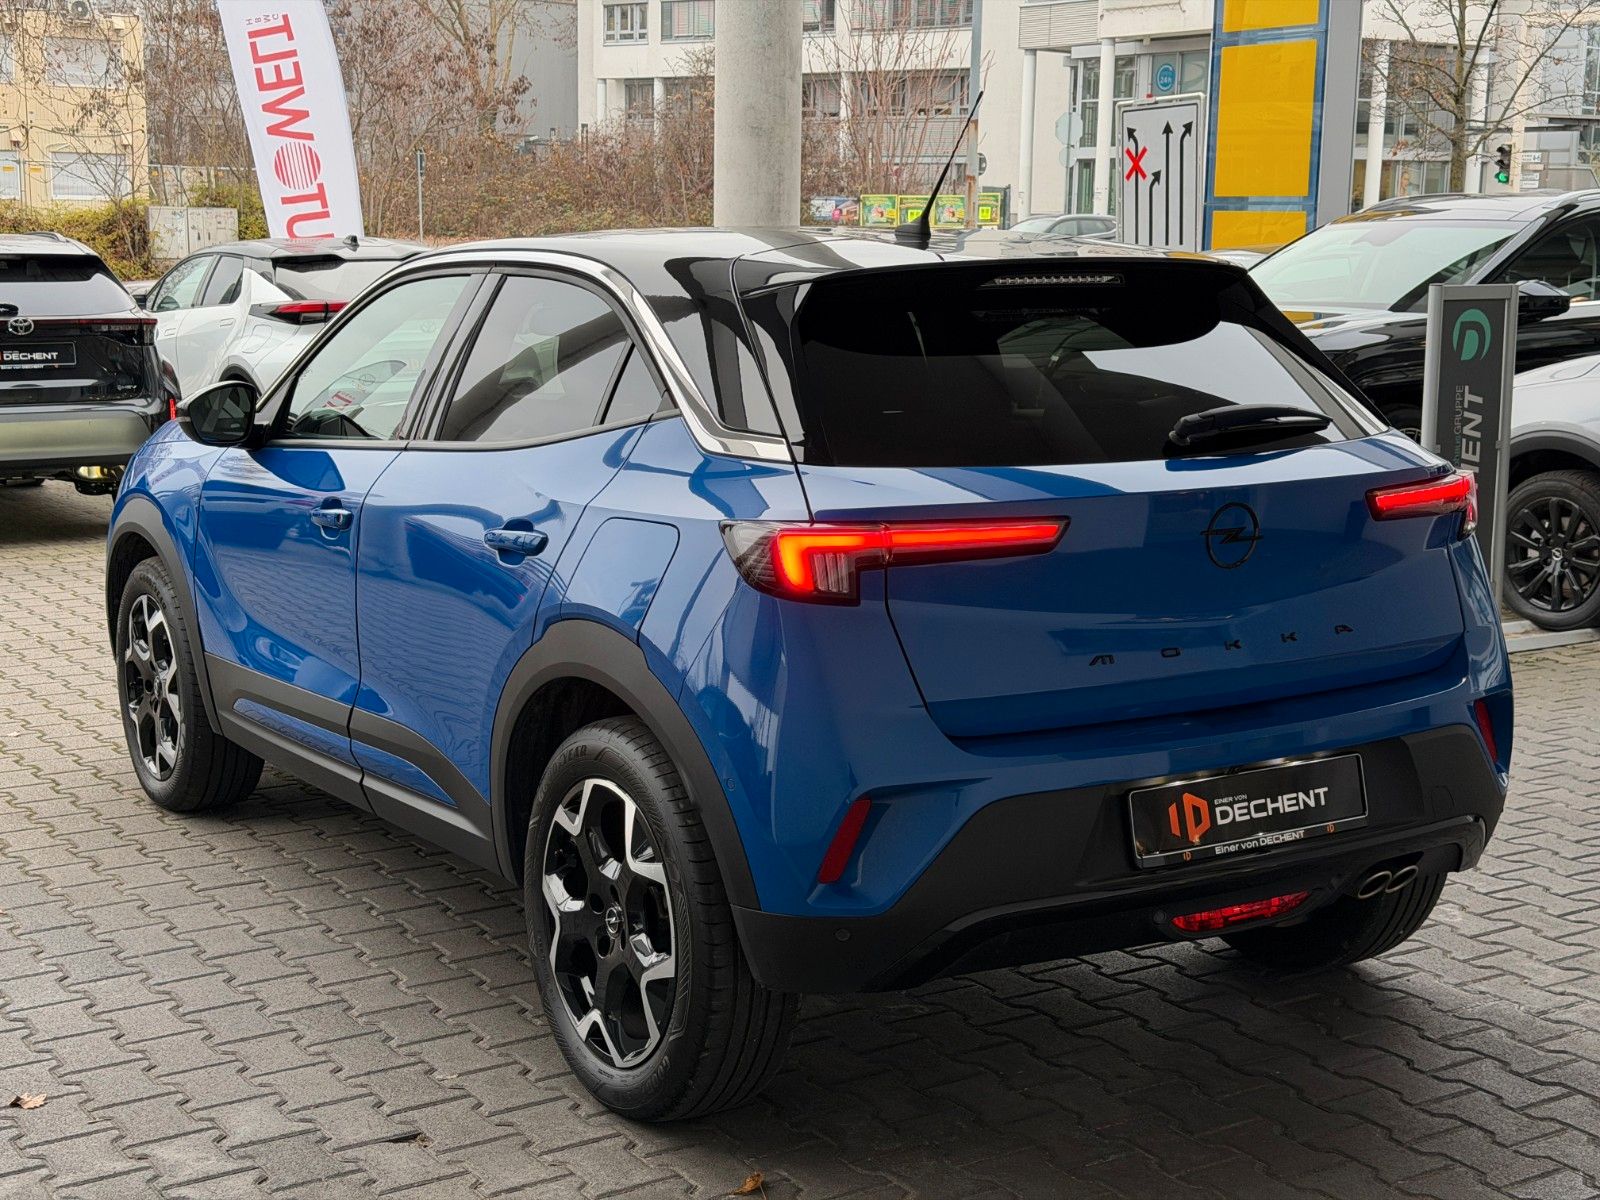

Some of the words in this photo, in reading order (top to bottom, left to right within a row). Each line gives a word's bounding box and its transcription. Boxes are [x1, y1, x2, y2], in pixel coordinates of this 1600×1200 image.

[3, 352, 58, 361] DECHENT
[1088, 624, 1354, 667] MOKKA
[1214, 796, 1233, 805] EINER
[1215, 786, 1329, 826] DECHENT
[1215, 843, 1239, 855] Einer
[1241, 839, 1259, 850] von
[1260, 830, 1305, 846] DECHENT
